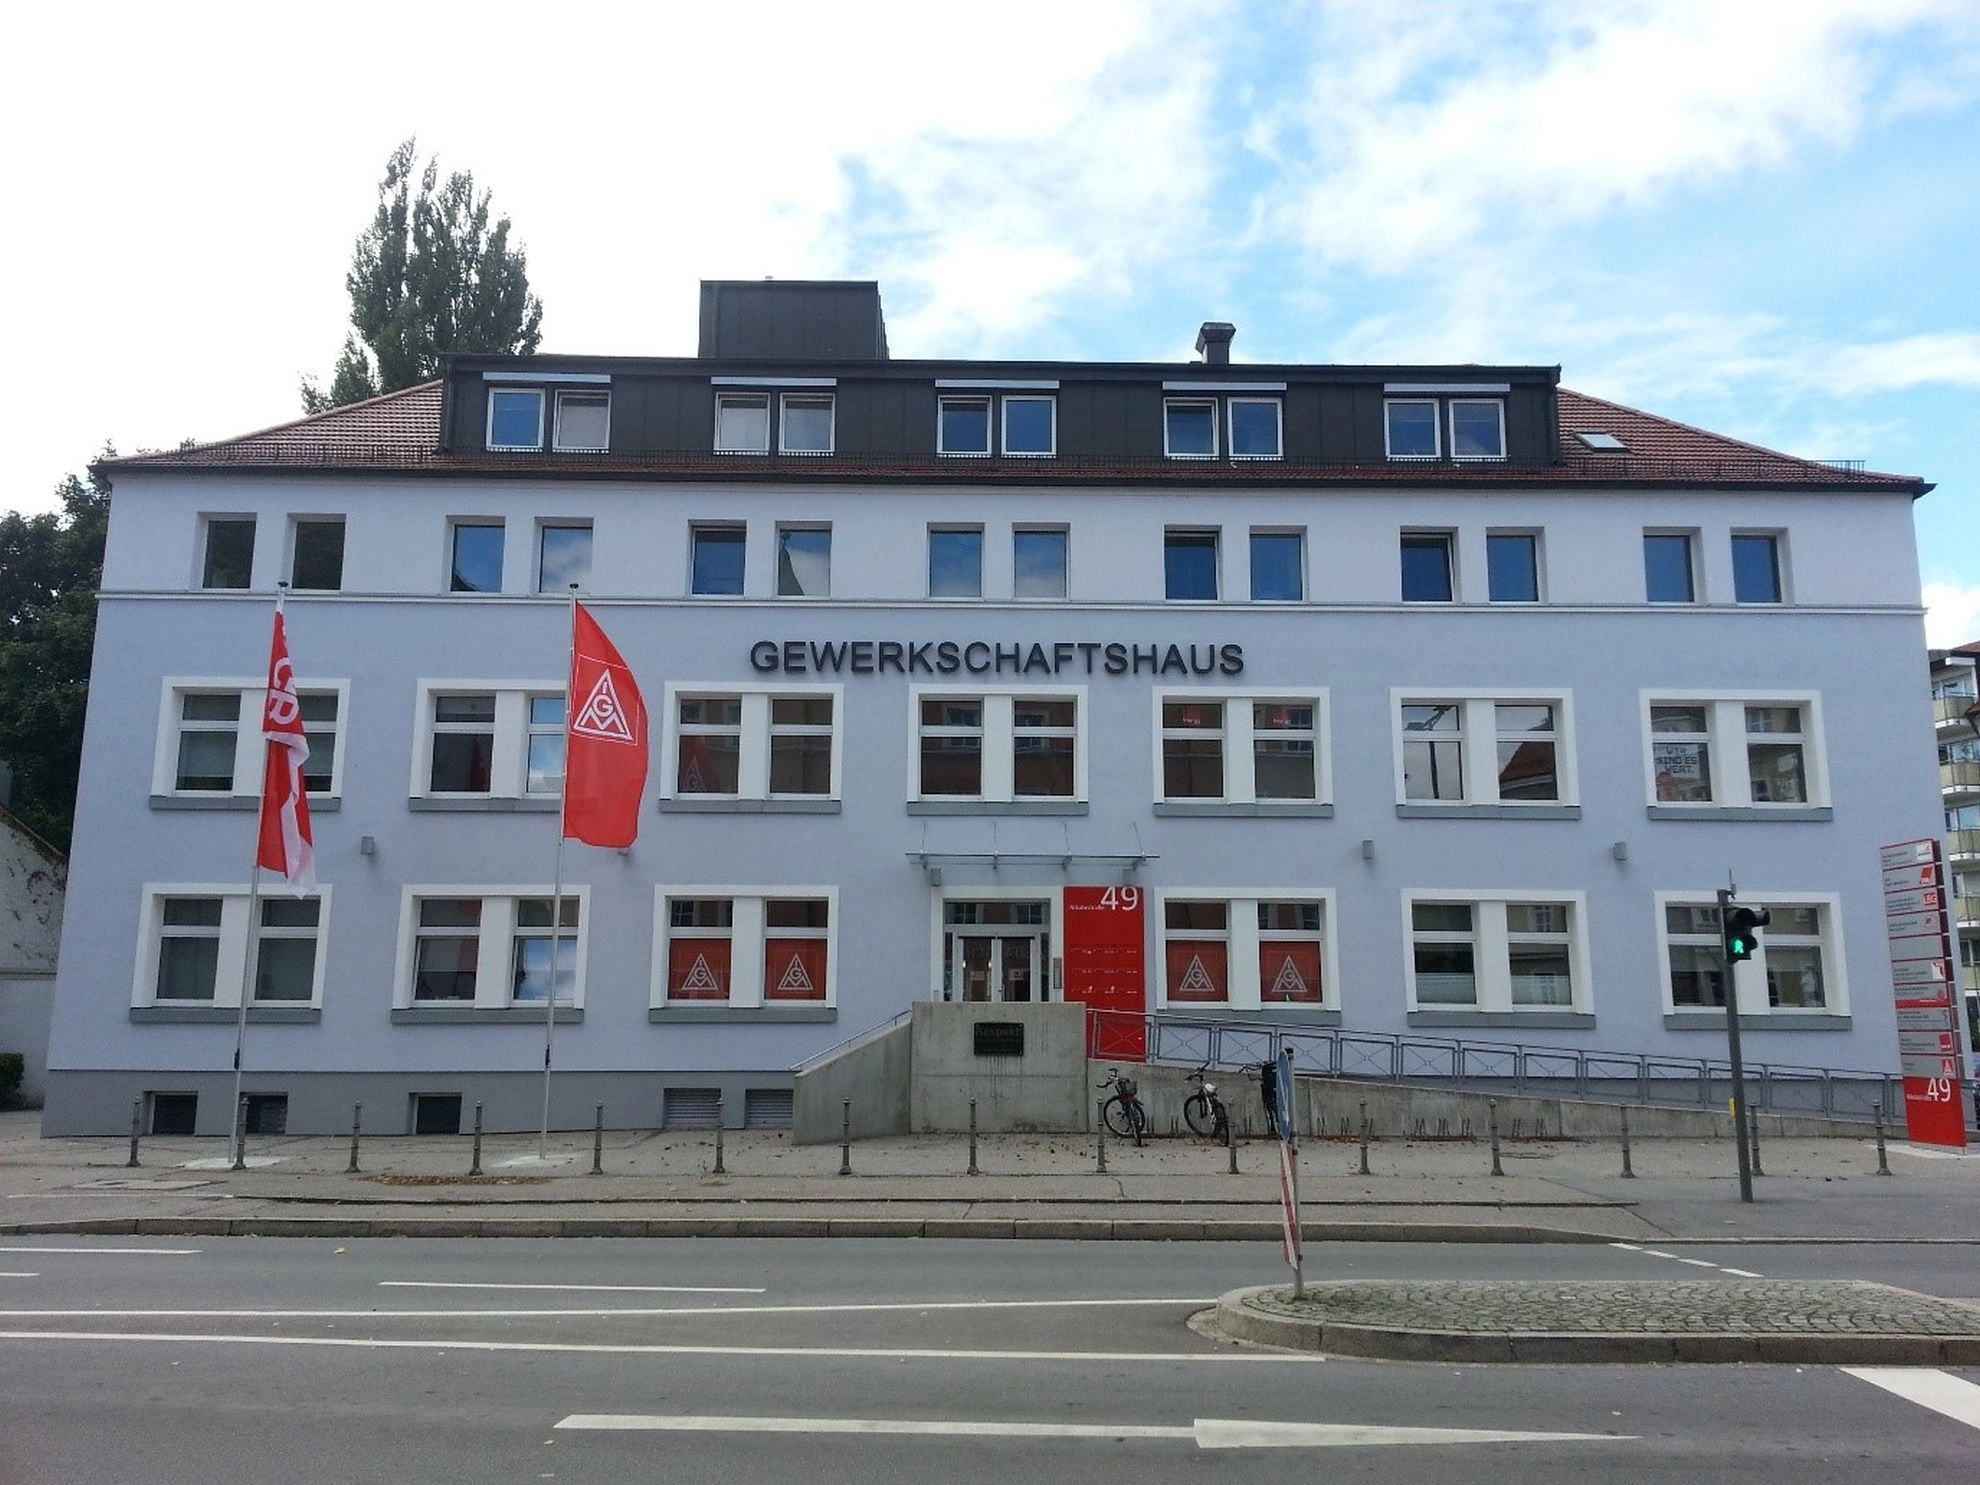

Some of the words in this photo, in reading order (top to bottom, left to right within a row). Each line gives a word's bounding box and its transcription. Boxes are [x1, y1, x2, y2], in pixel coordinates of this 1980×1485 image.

[749, 640, 1245, 675] GEWERKSCHAFTSHAUS
[1100, 886, 1138, 911] 49
[1927, 1078, 1951, 1102] 49
